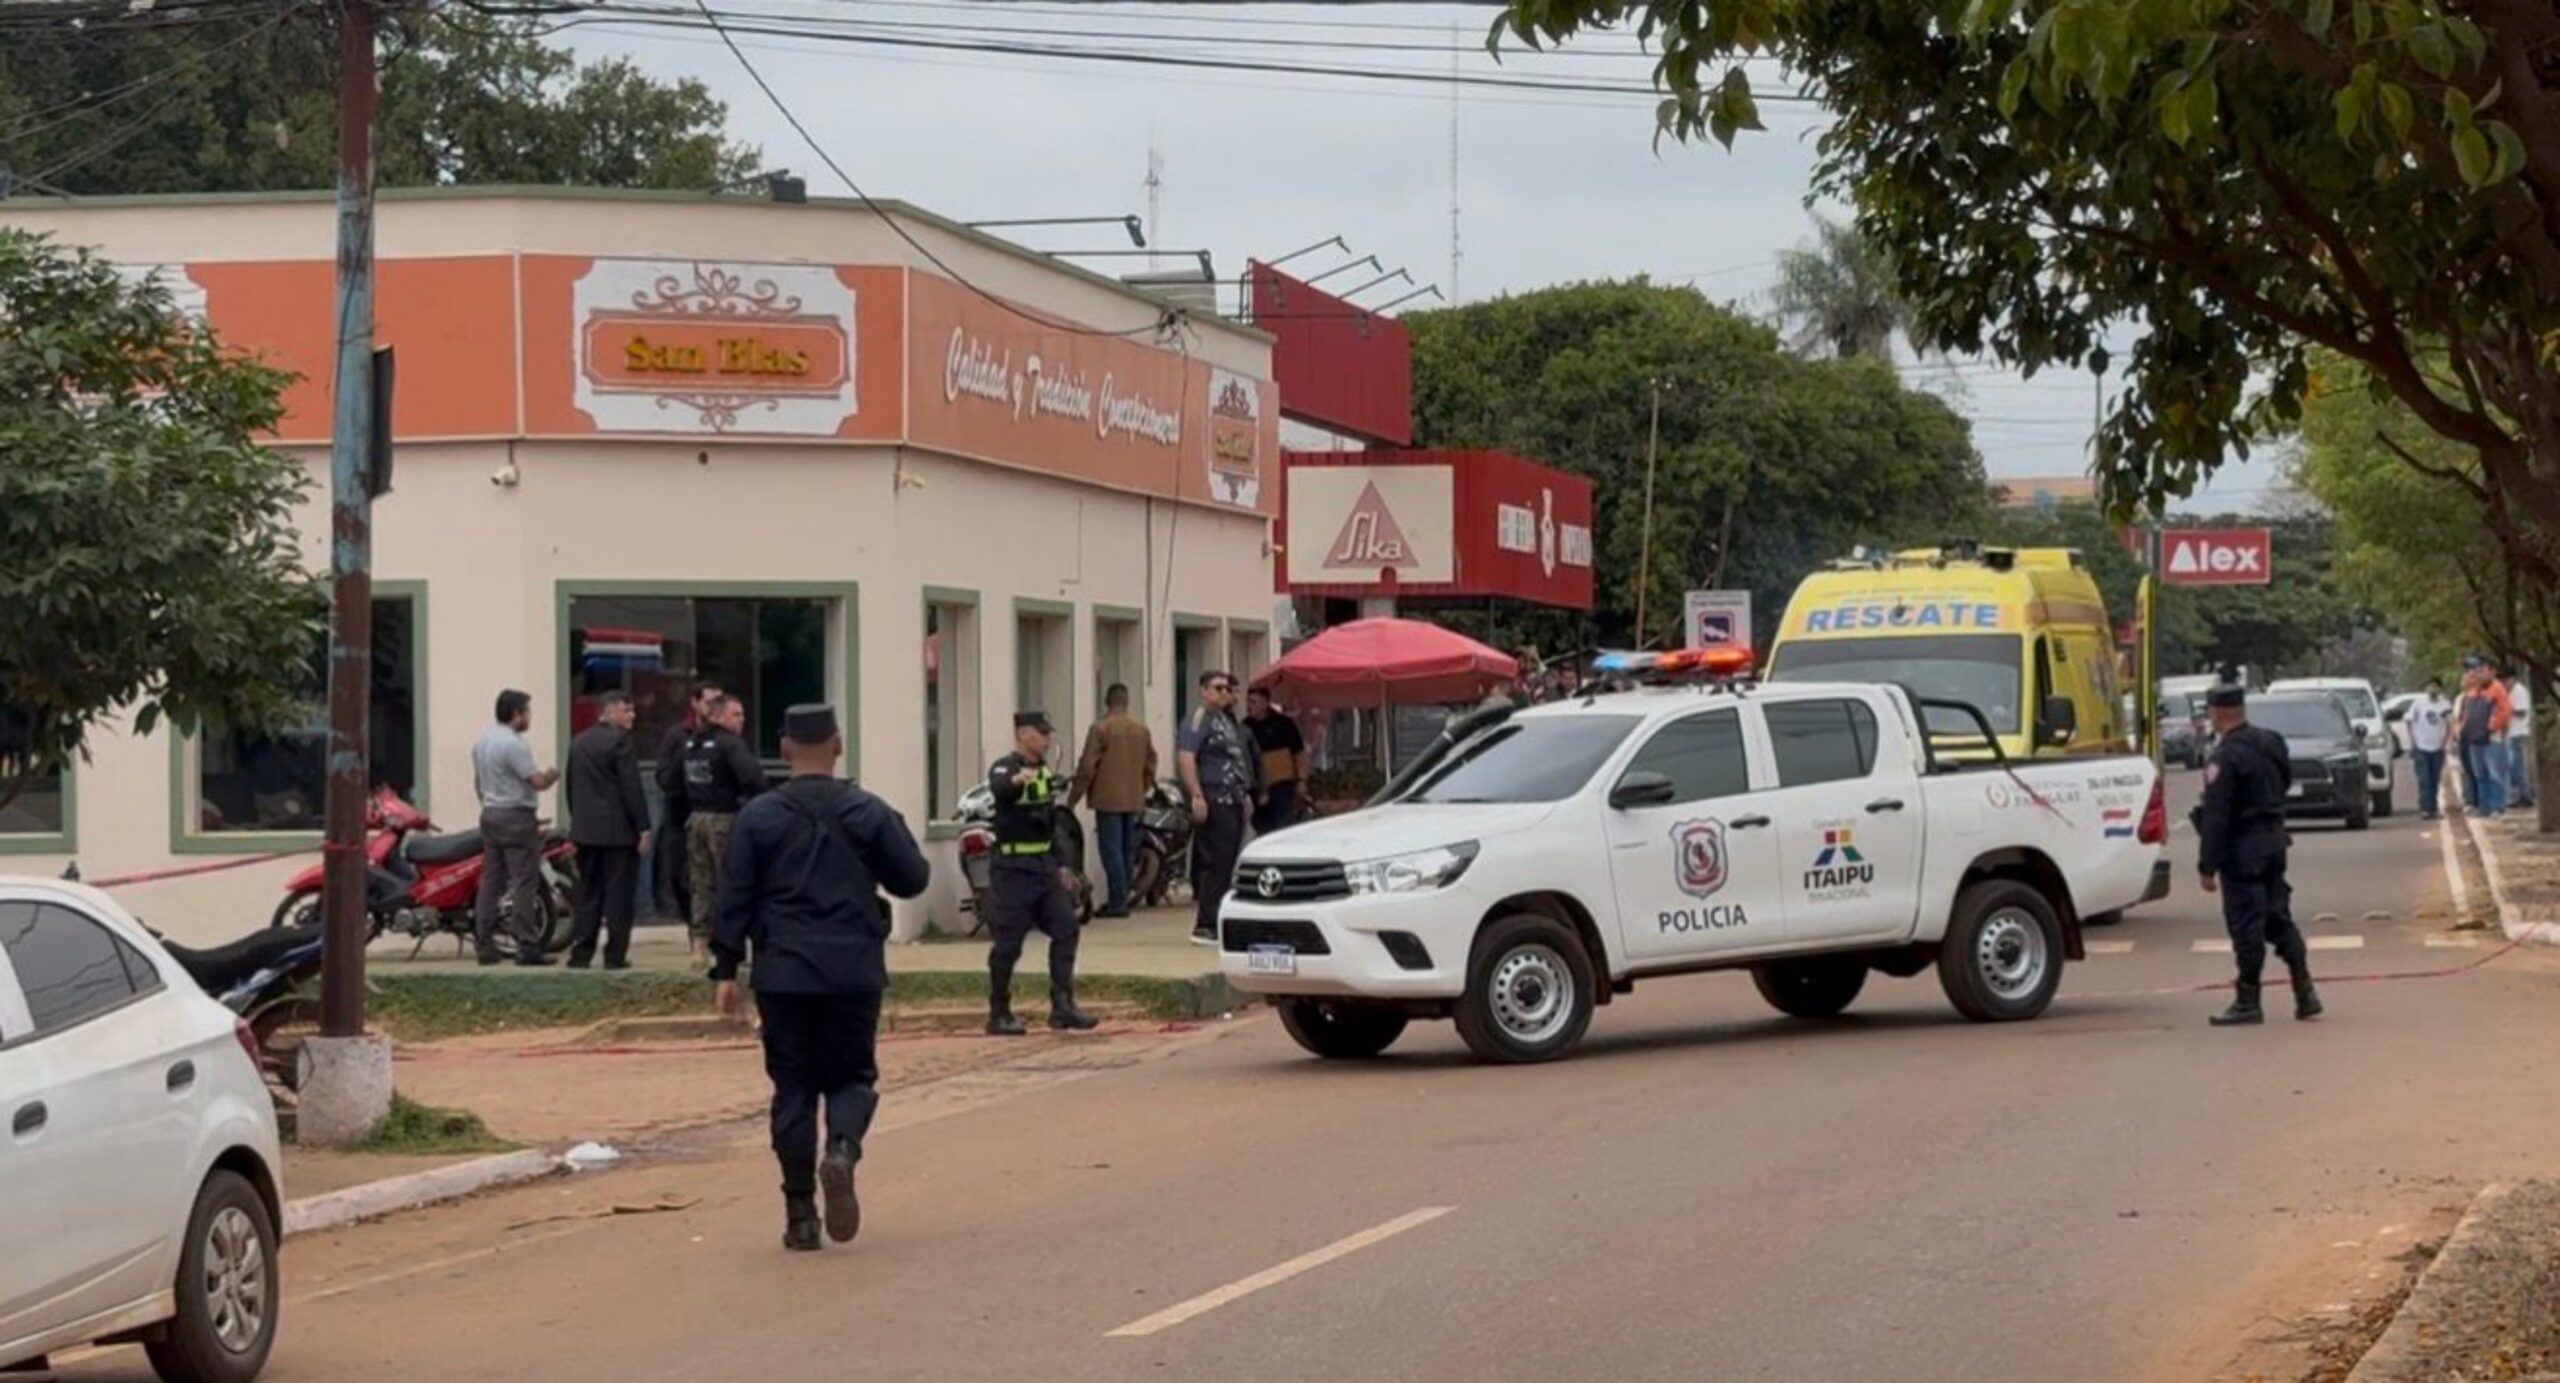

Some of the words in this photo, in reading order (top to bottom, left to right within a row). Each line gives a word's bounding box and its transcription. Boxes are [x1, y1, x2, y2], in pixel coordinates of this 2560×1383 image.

[624, 337, 706, 373] San
[945, 325, 1009, 402] Calidad
[1012, 372, 1024, 423] y
[1336, 511, 1404, 562] Sika
[2168, 539, 2261, 572] Alex
[1806, 601, 1999, 633] RESCATE
[1803, 863, 1875, 891] ITAIPU
[1657, 903, 1749, 934] POLICIA
